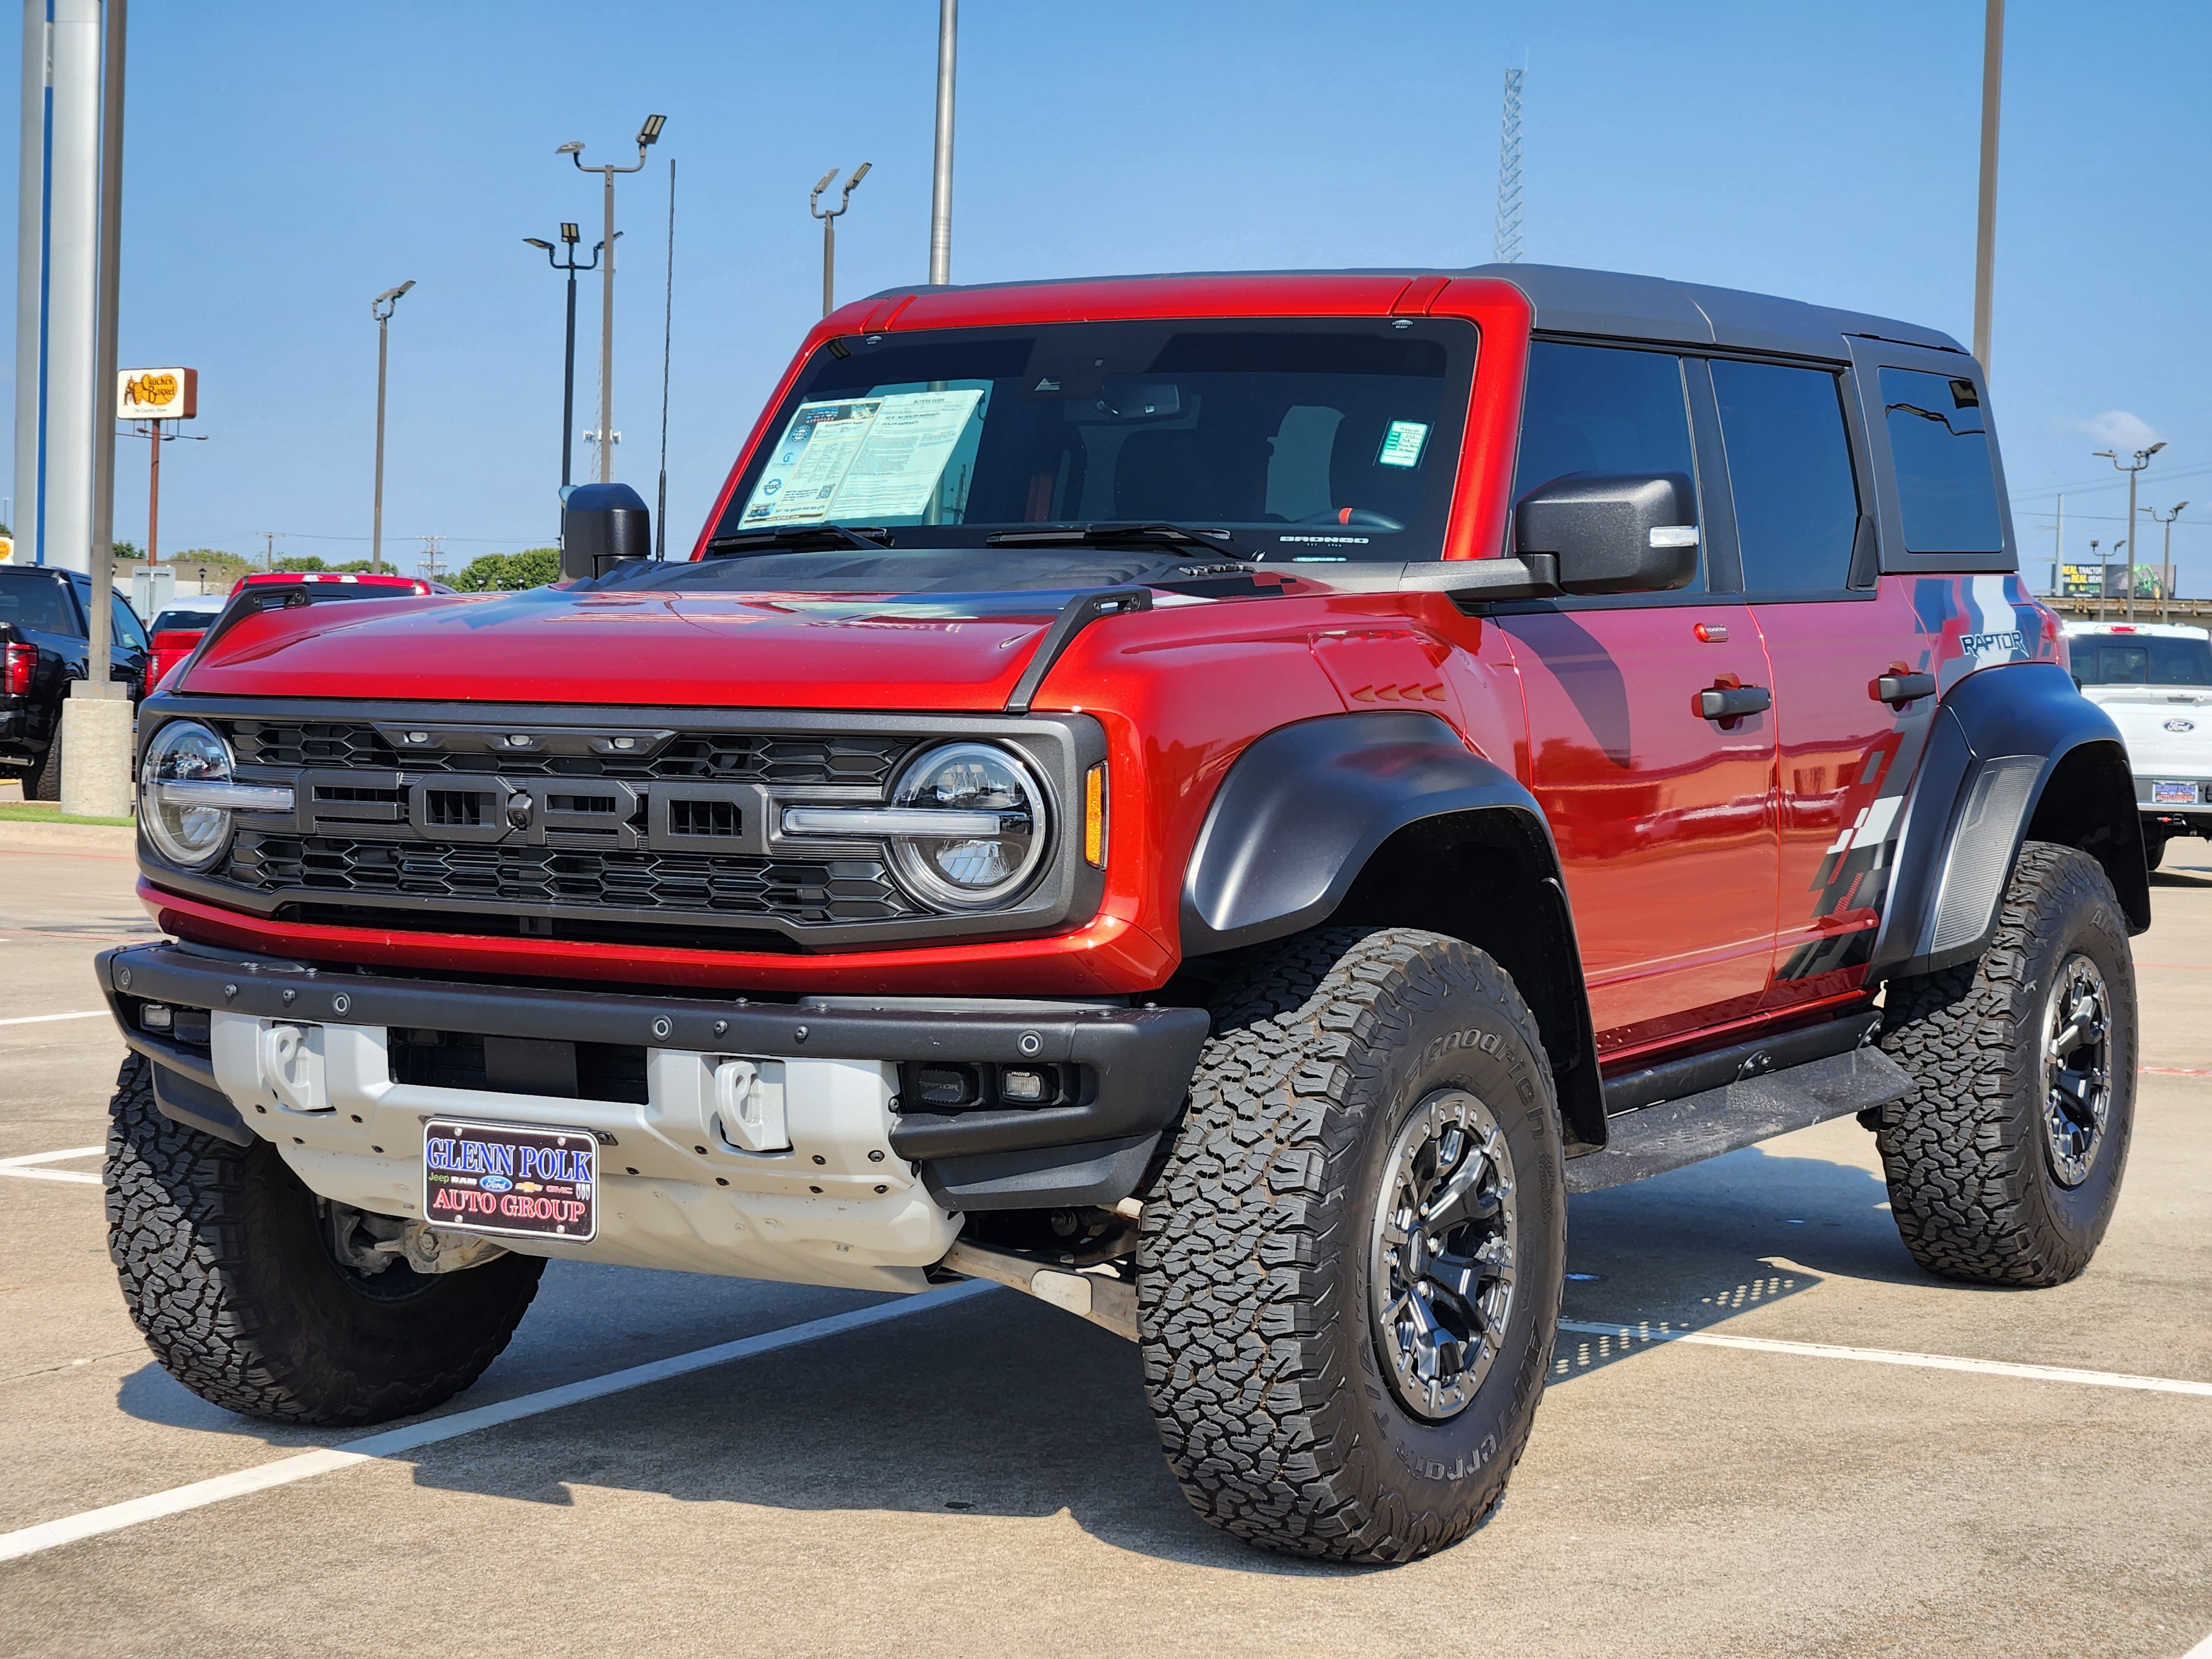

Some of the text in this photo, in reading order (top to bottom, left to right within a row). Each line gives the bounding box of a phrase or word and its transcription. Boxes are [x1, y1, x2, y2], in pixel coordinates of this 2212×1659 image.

[1280, 536, 1369, 544] BRONCO
[2063, 565, 2078, 575] REAL
[2071, 574, 2088, 584] REAL
[1959, 630, 2031, 662] RAPTOR
[2168, 720, 2190, 731] Ford
[297, 766, 772, 855] FORD
[426, 1137, 593, 1183] GLENN POLK
[428, 1172, 573, 1195] Jeep RAM Ford GMC
[432, 1188, 586, 1223] AUTO GROUP
